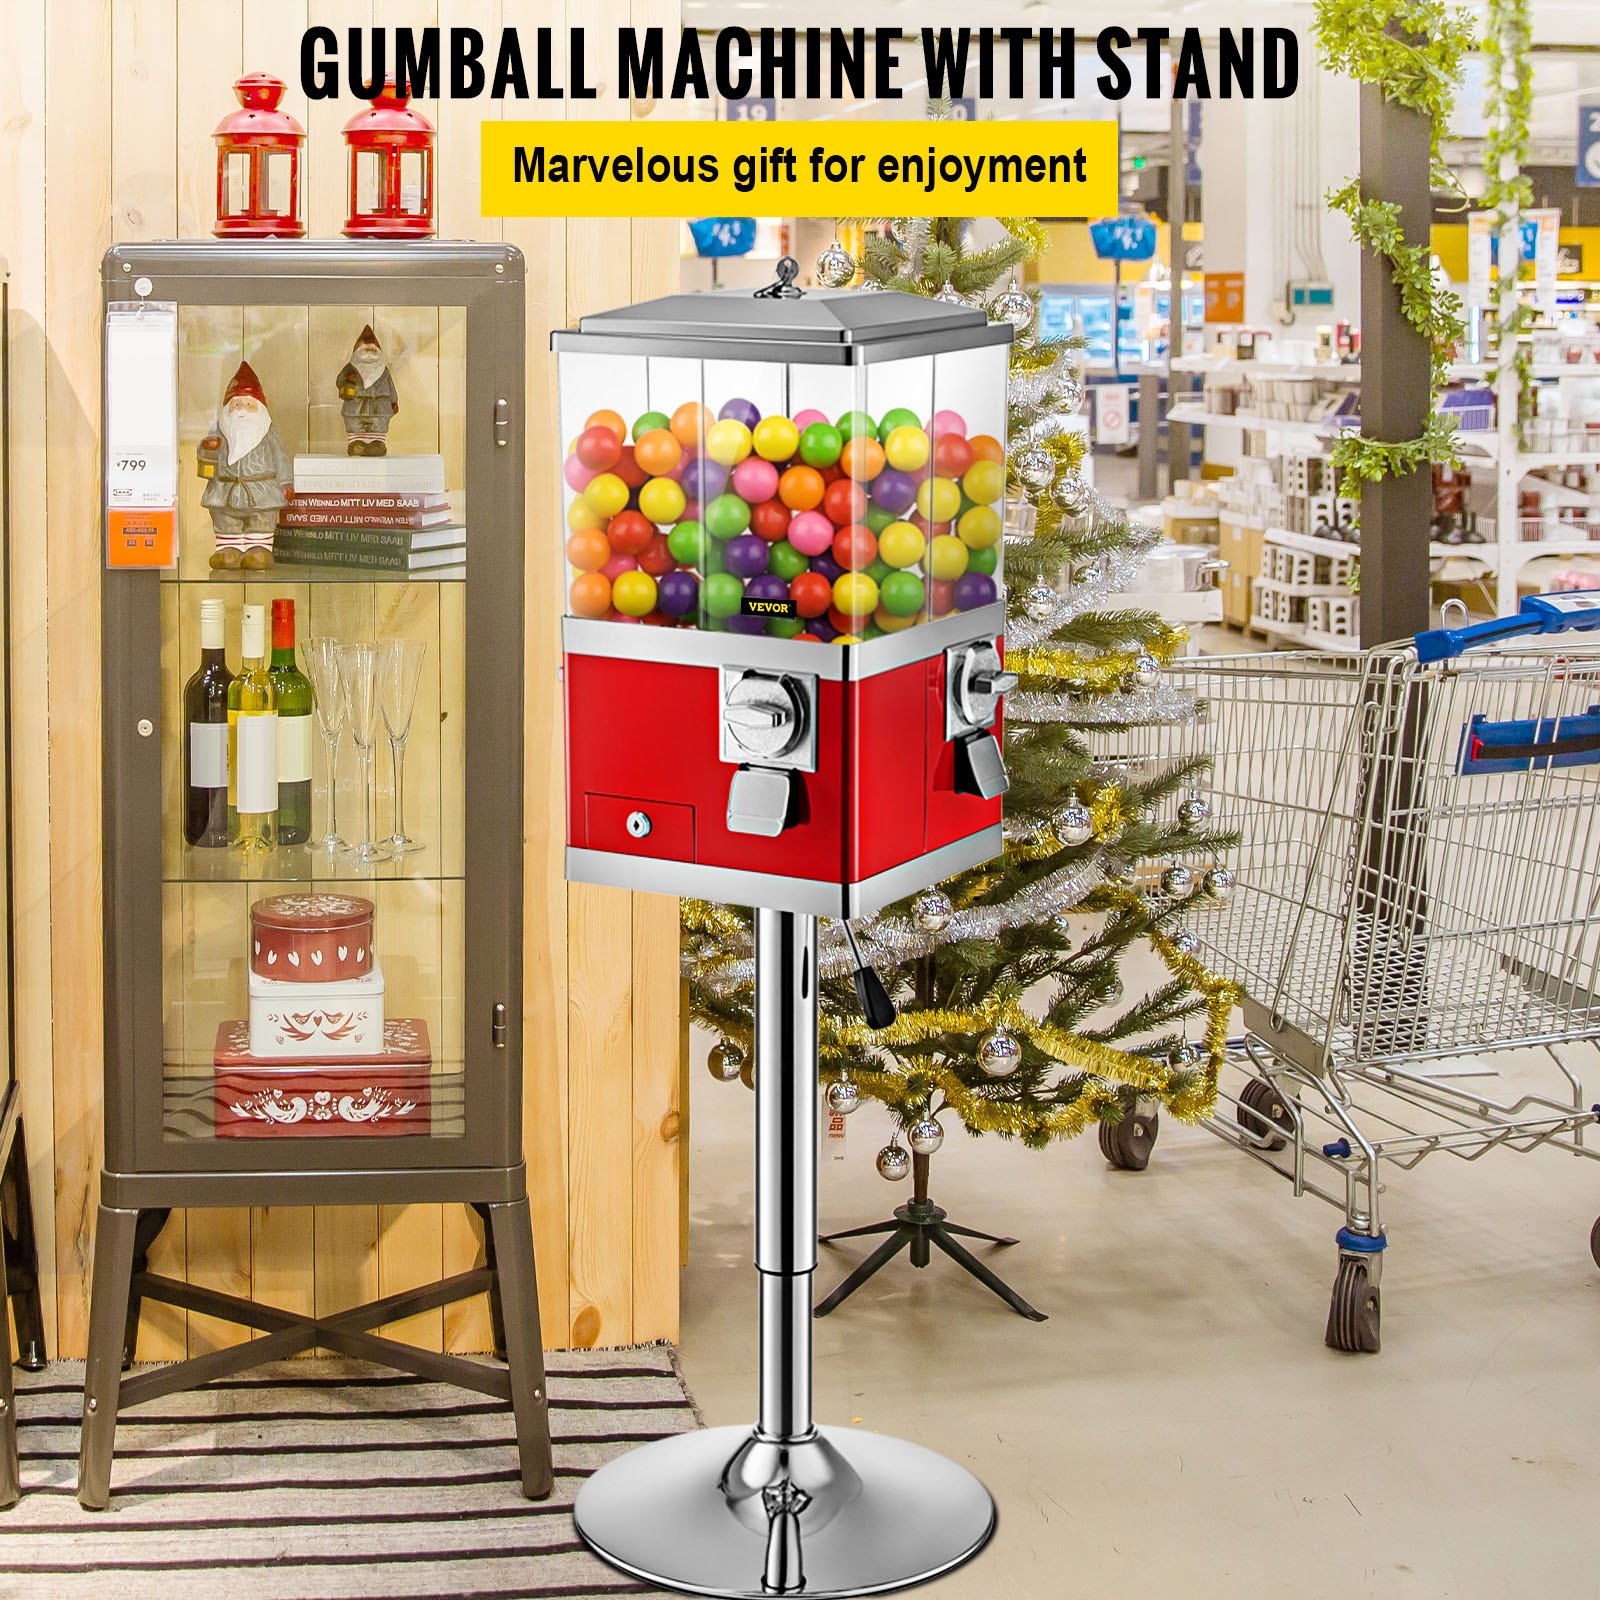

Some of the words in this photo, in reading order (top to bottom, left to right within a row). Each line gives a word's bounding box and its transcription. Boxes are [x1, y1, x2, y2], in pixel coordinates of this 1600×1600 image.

[117, 460, 146, 471] ¥799
[341, 498, 361, 507] MITT
[362, 498, 375, 507] LIV
[376, 499, 395, 507] MED
[396, 499, 419, 508] SAAB
[310, 514, 328, 523] MED
[324, 531, 345, 541] MITT
[346, 532, 359, 541] LIV
[360, 533, 379, 543] MED
[748, 601, 789, 613] VEVOR
